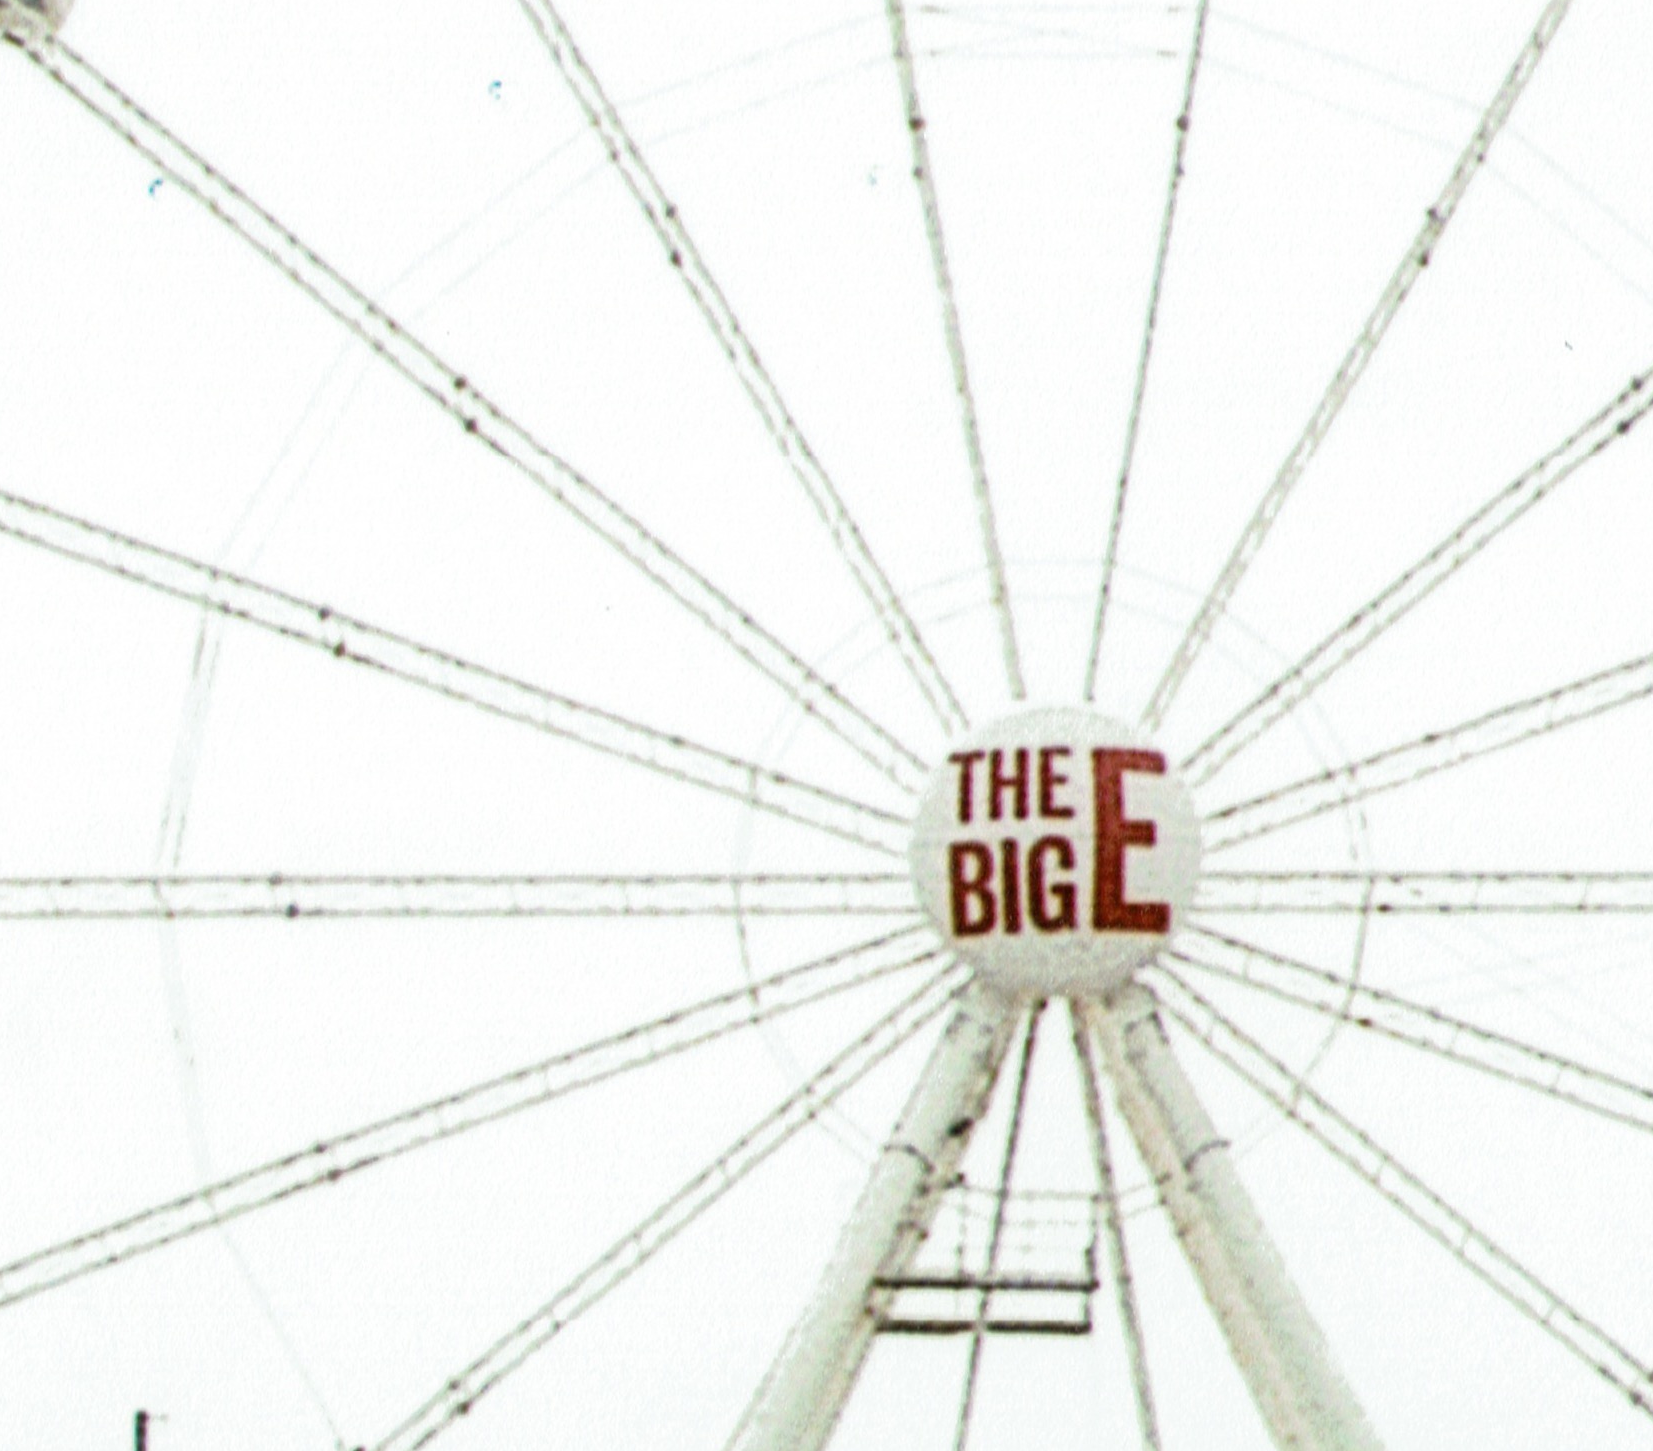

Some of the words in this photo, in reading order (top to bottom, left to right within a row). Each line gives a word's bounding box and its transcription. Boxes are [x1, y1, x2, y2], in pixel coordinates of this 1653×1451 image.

[947, 746, 1075, 824] THE
[948, 835, 1078, 938] BIG
[1090, 747, 1171, 934] E
